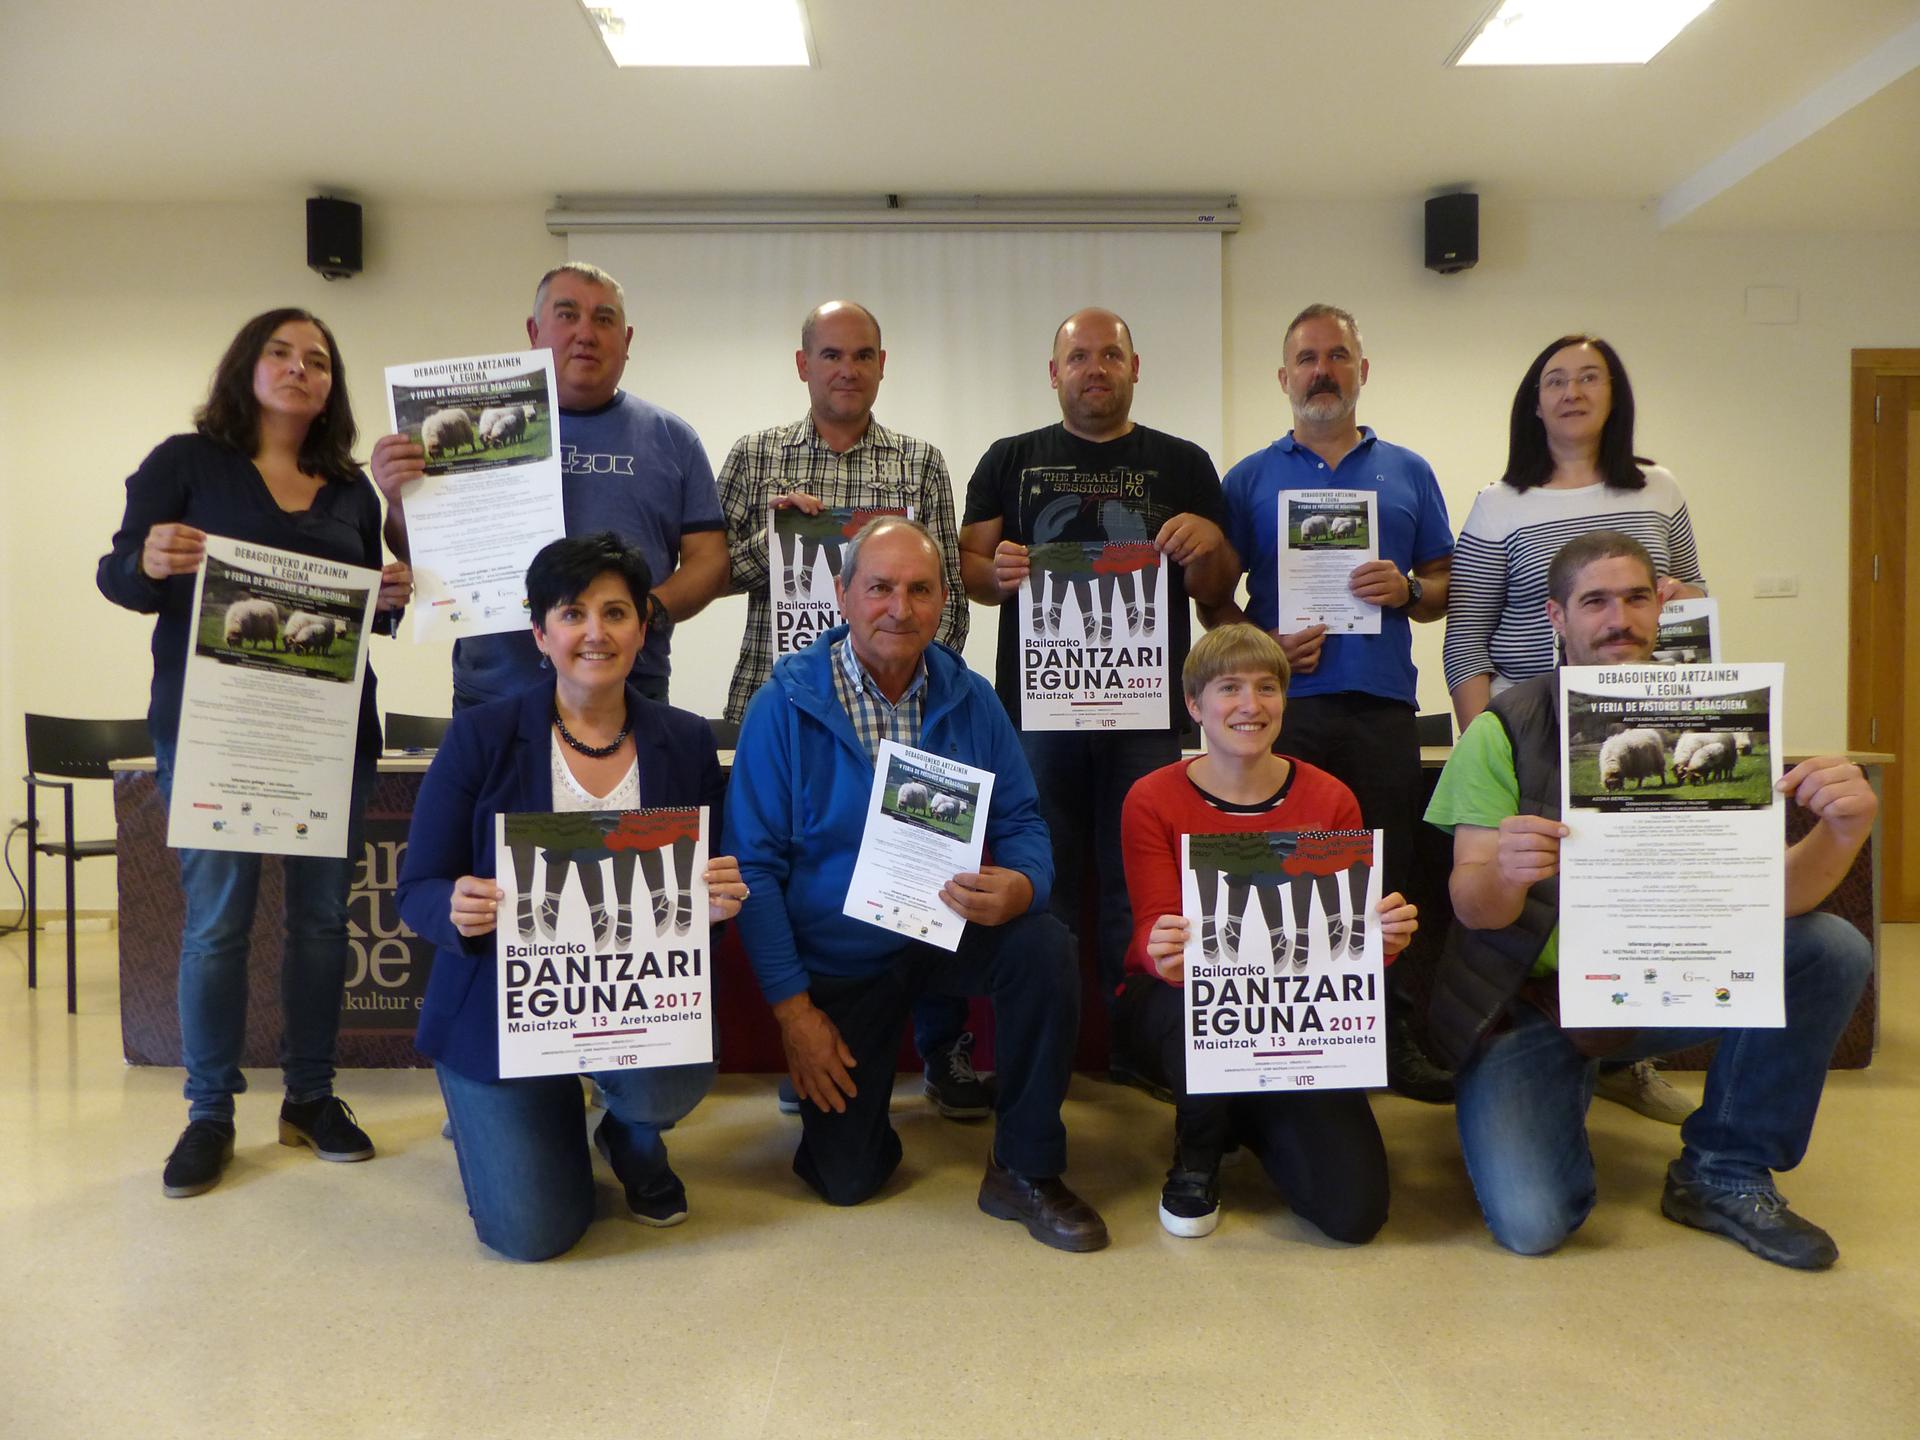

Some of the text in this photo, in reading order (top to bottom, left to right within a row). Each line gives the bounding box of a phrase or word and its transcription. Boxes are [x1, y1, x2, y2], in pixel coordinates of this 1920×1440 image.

[414, 357, 522, 378] DEBAGOIENEKO ARTZAINEN
[460, 371, 488, 383] EGUNA
[416, 389, 436, 400] FERIA
[447, 385, 479, 397] PASTORES
[490, 379, 532, 392] DEBAGOIENA
[1042, 472, 1144, 484] THE PEARL 19
[1053, 482, 1144, 498] SESSIONS 70
[235, 547, 349, 580] DEBAGOIENEKO ARTZAINEN
[281, 568, 309, 582] EGUNA
[264, 578, 297, 592] PASTORES
[777, 600, 831, 610] Bailarako
[1025, 638, 1080, 648] Bailarako
[1025, 646, 1162, 669] DANTZARI
[1025, 669, 1162, 690] EGUNA 2017
[1598, 670, 1739, 684] DEBAGOIENEKO ARTZAINEN
[1026, 690, 1162, 700] Maiatzak 13 Aretxabaleta
[1645, 684, 1692, 696] V. EGUNA
[1590, 699, 1748, 713] V FERIA DE PASTORES DE DEBAGOIENA
[506, 942, 586, 957] Bailarako
[506, 949, 702, 988] DANTZARI
[1192, 964, 1266, 978] Bailarako
[1731, 970, 1754, 979] hazi
[1192, 973, 1375, 1007] DANTZARI
[345, 991, 410, 1010] kultur
[506, 983, 702, 1019] EGUNA 2017
[508, 1011, 702, 1033] Maiatzak 13 Aretxabaleta
[1192, 1005, 1376, 1036] EGUNA 2017
[1193, 1034, 1376, 1050] Maiatzak 13 Aretxabaleta
